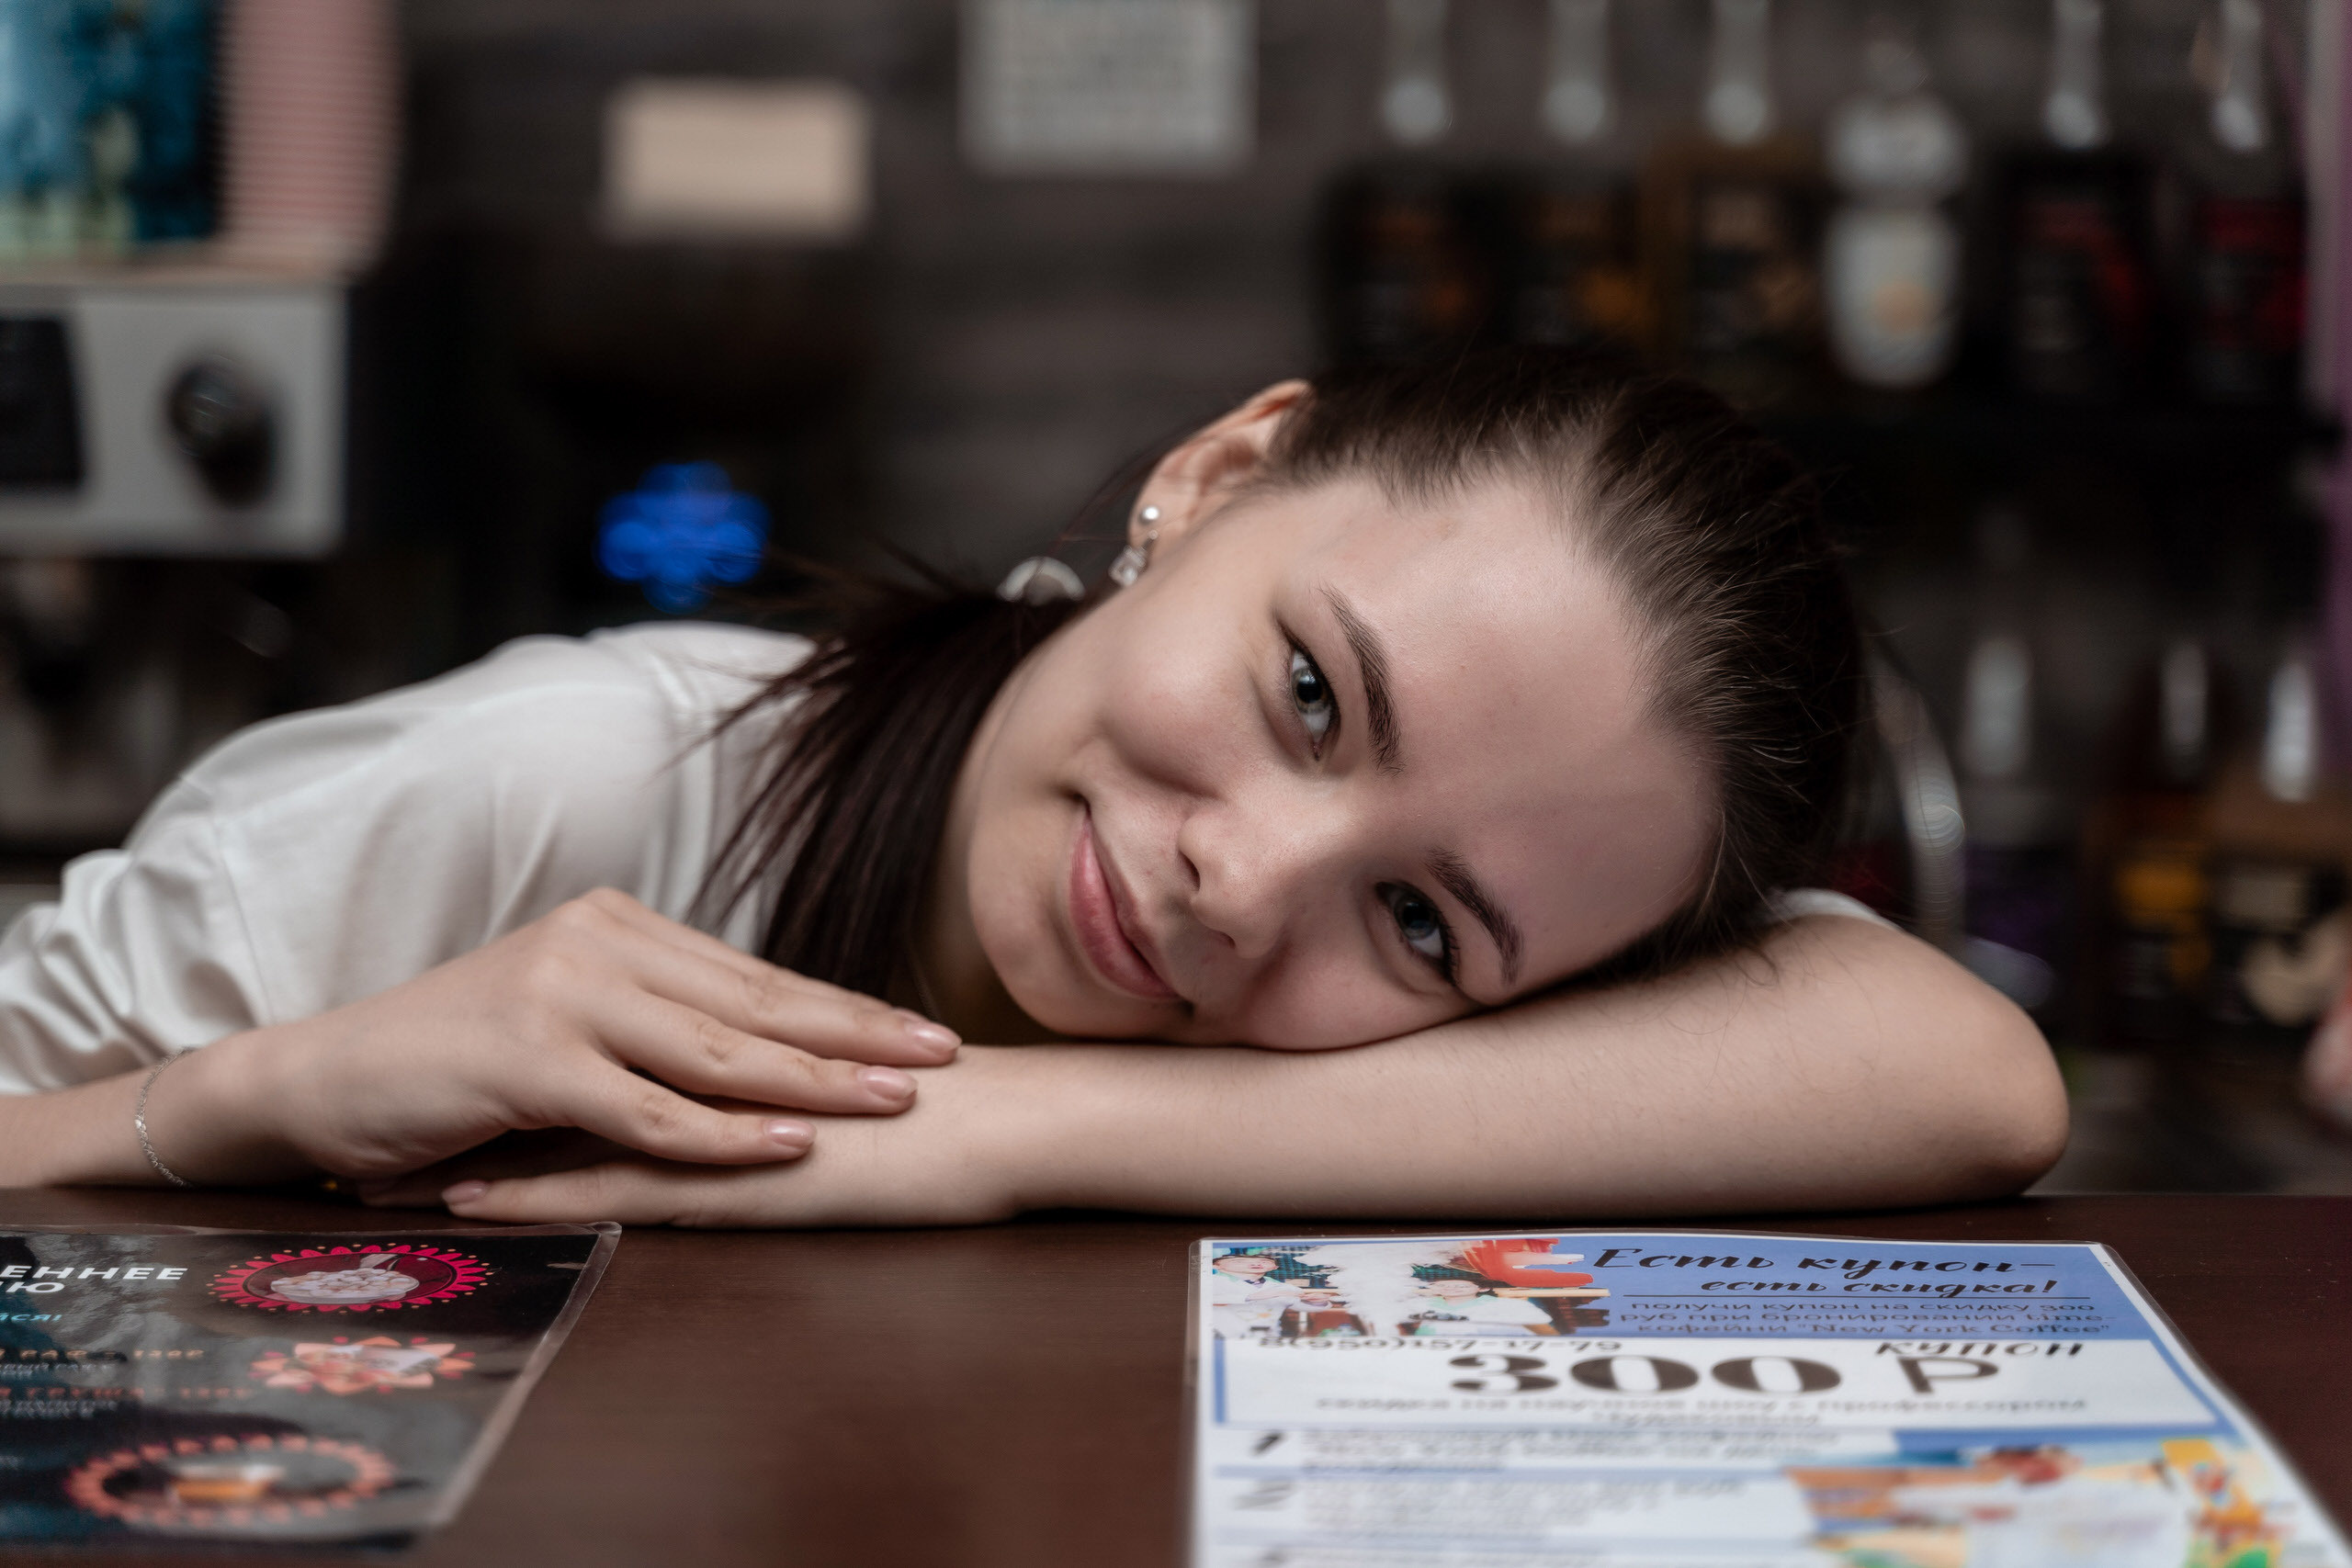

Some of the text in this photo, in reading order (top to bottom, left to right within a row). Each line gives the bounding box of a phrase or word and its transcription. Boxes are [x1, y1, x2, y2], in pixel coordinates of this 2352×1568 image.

[1593, 1248, 1774, 1269] Есть
[1701, 1280, 2058, 1298] есть скидка!
[1631, 1303, 1751, 1311] получи
[1762, 1303, 1860, 1311] купон
[1919, 1303, 2030, 1312] скидку
[1620, 1313, 1678, 1322] руб
[1689, 1314, 1750, 1322] при
[1761, 1314, 2016, 1322] бронировании
[1638, 1323, 1788, 1334] кофейни
[1896, 1324, 1977, 1333] York
[1448, 1355, 1842, 1396] 300
